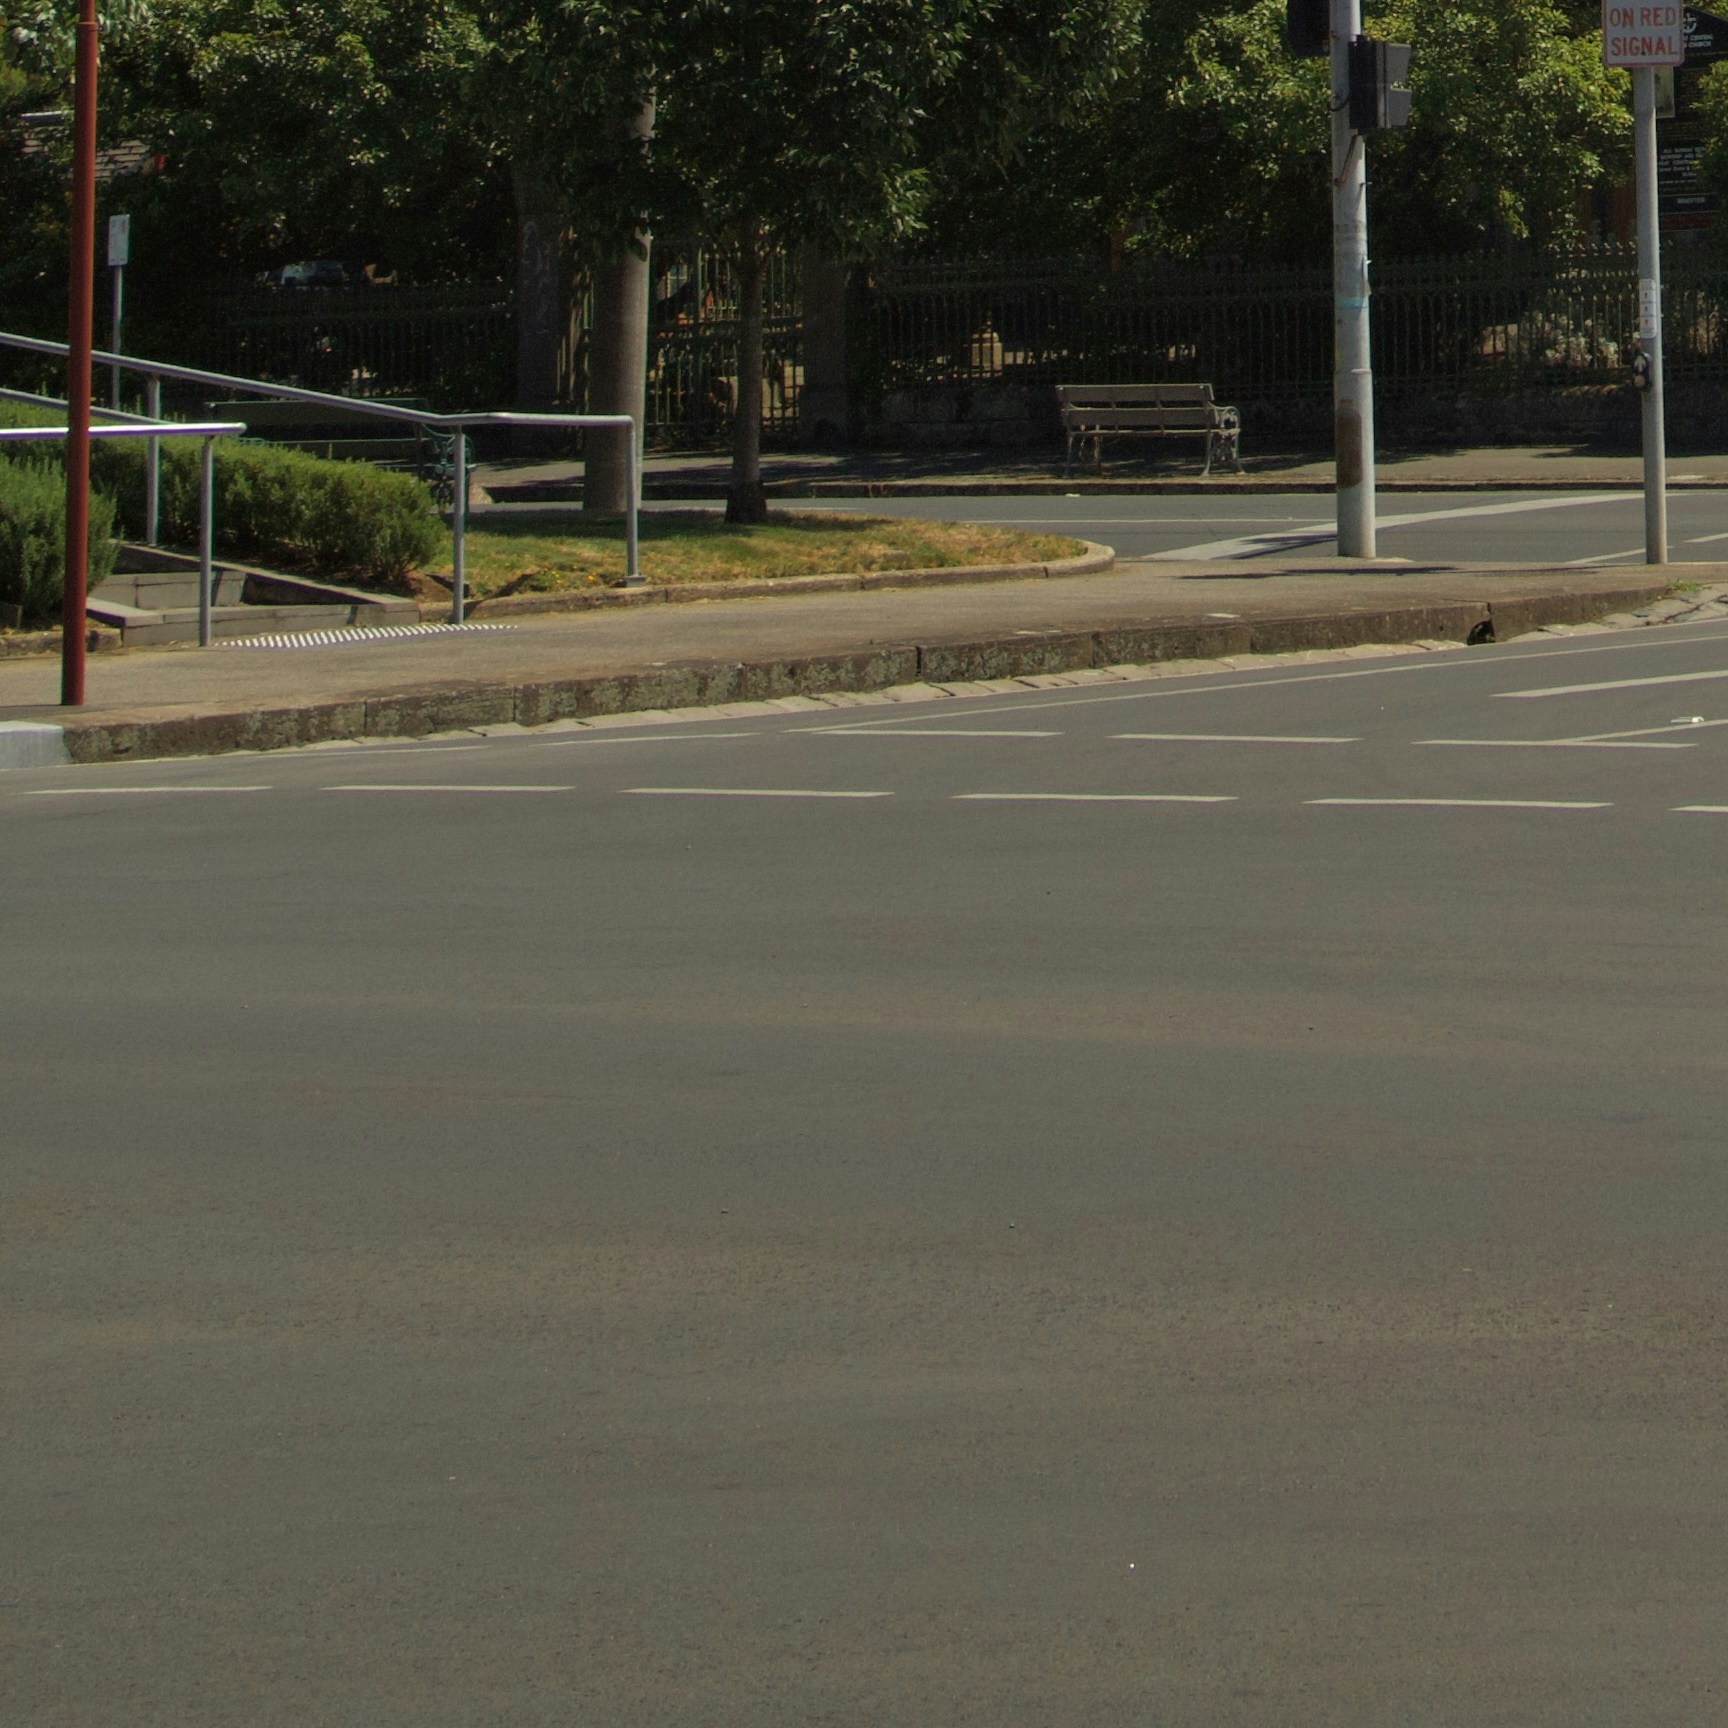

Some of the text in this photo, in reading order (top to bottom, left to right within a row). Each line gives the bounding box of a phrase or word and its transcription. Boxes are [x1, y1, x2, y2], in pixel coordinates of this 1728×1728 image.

[1610, 6, 1676, 29] ON RED
[1611, 36, 1679, 57] SIGNAL
